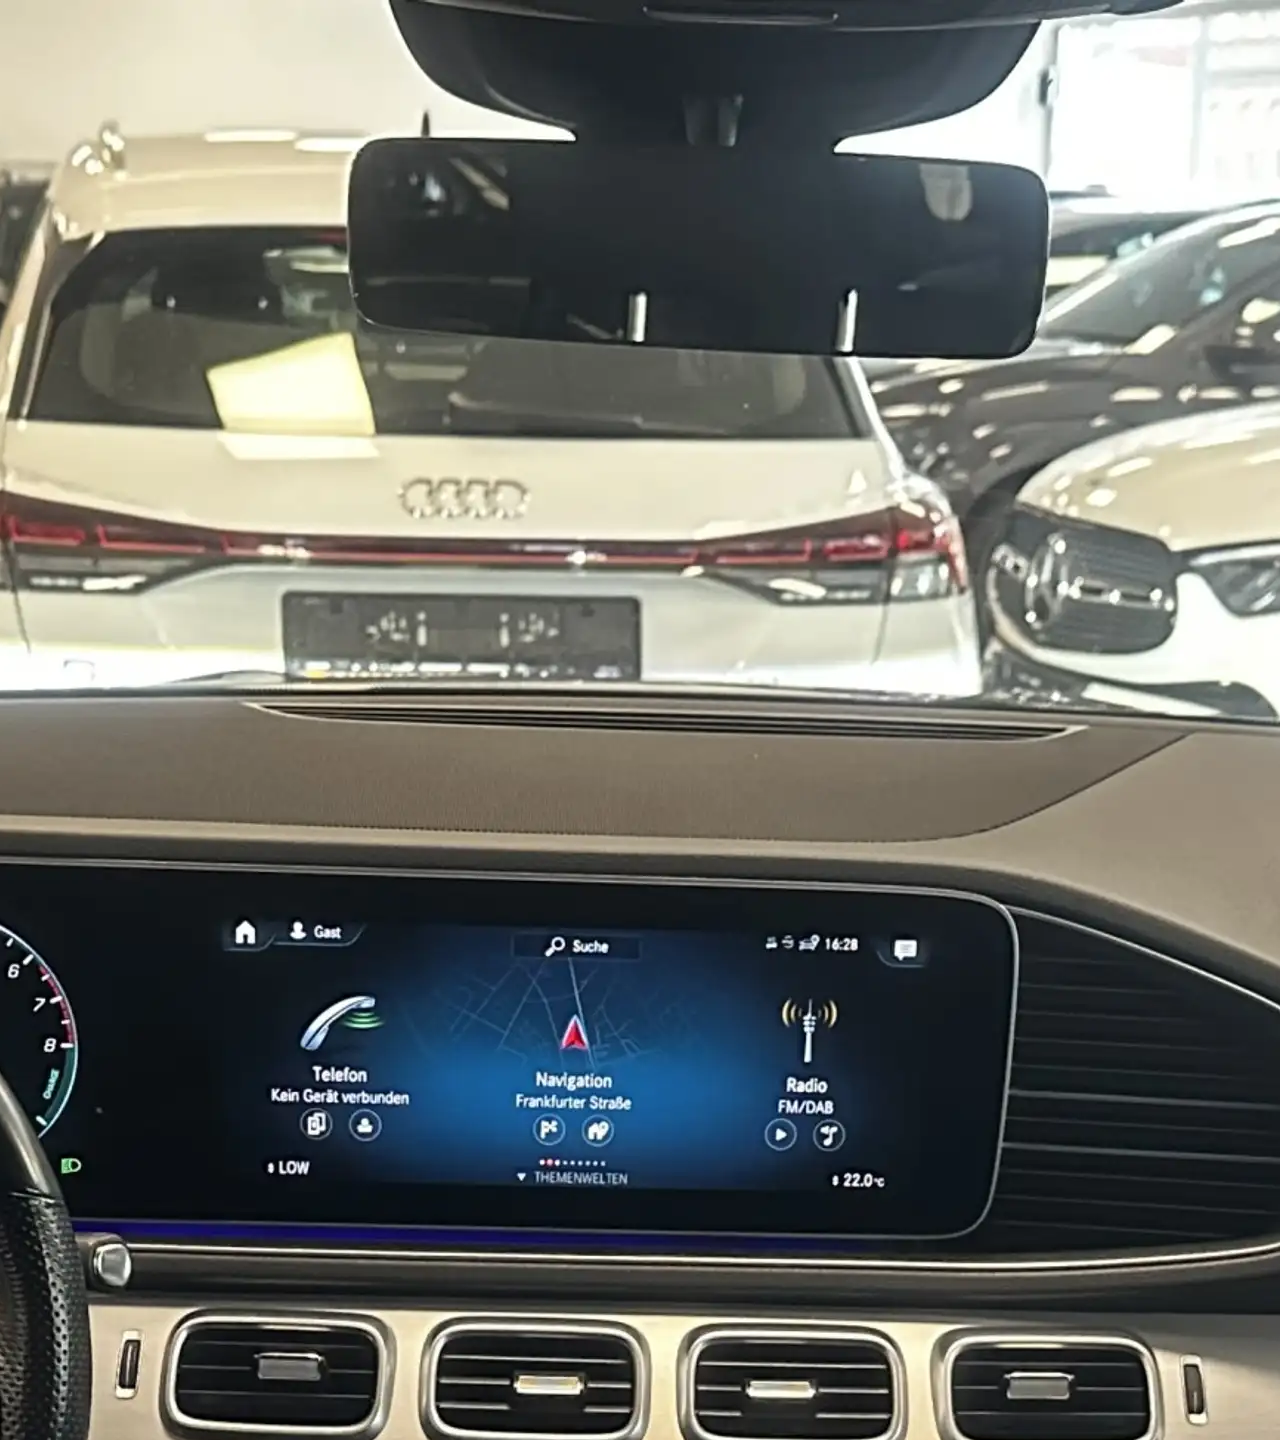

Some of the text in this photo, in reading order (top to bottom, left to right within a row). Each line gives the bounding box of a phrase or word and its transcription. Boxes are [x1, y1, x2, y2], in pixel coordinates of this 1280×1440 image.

[313, 925, 341, 939] Gast
[572, 939, 609, 954] Suche
[824, 937, 858, 952] 16:28
[7, 963, 20, 979] 6
[33, 997, 46, 1012] 7
[43, 1038, 57, 1053] 8
[312, 1065, 368, 1084] Telefon
[535, 1072, 613, 1091] Navigation
[786, 1077, 828, 1095] Radio
[271, 1088, 410, 1106] Kein Gerät verbunden
[515, 1094, 632, 1111] Frankfurter Straße
[777, 1100, 834, 1116] FM/DAB
[278, 1160, 310, 1176] LOW
[534, 1171, 629, 1187] THEMENWELTEN
